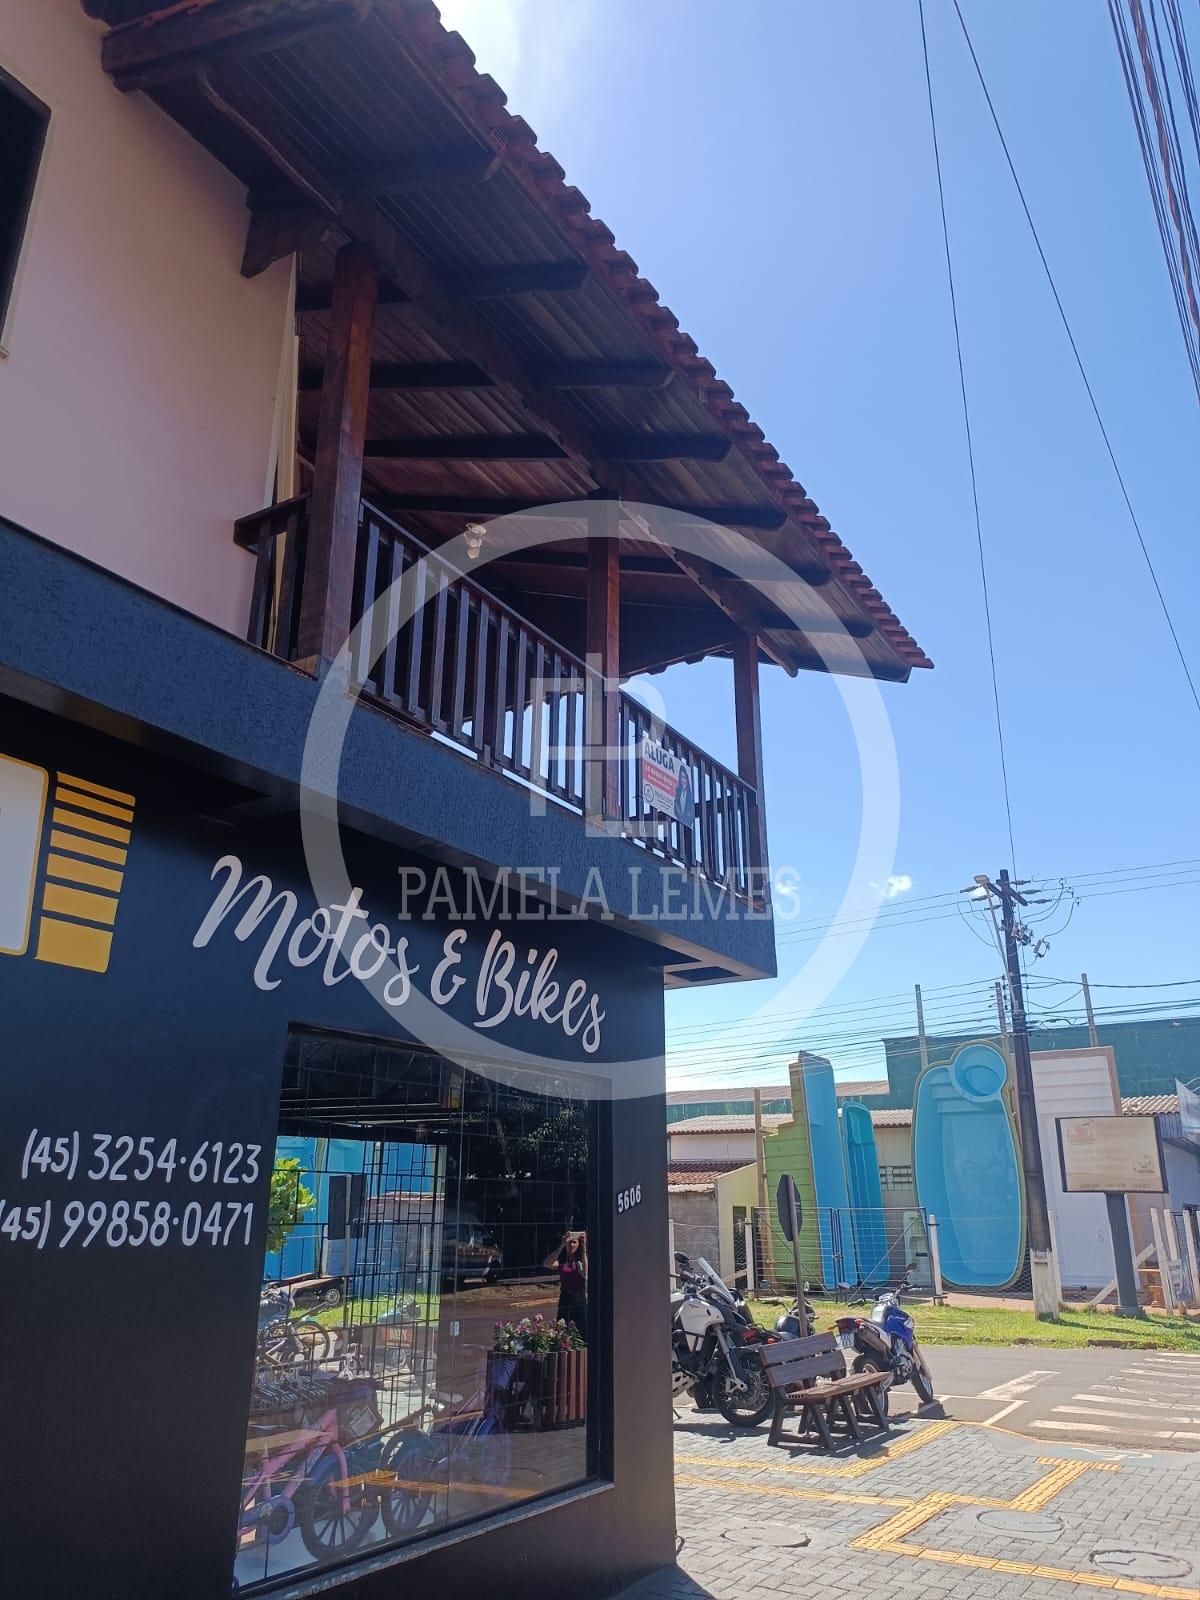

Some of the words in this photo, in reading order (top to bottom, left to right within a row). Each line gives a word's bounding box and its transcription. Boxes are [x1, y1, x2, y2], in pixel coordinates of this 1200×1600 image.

[644, 742, 675, 774] ALUGA
[192, 854, 420, 1006] Motos
[430, 928, 468, 1005] &
[473, 928, 606, 1054] Bikes
[21, 1128, 80, 1181] (45)
[617, 1184, 642, 1213] 5606
